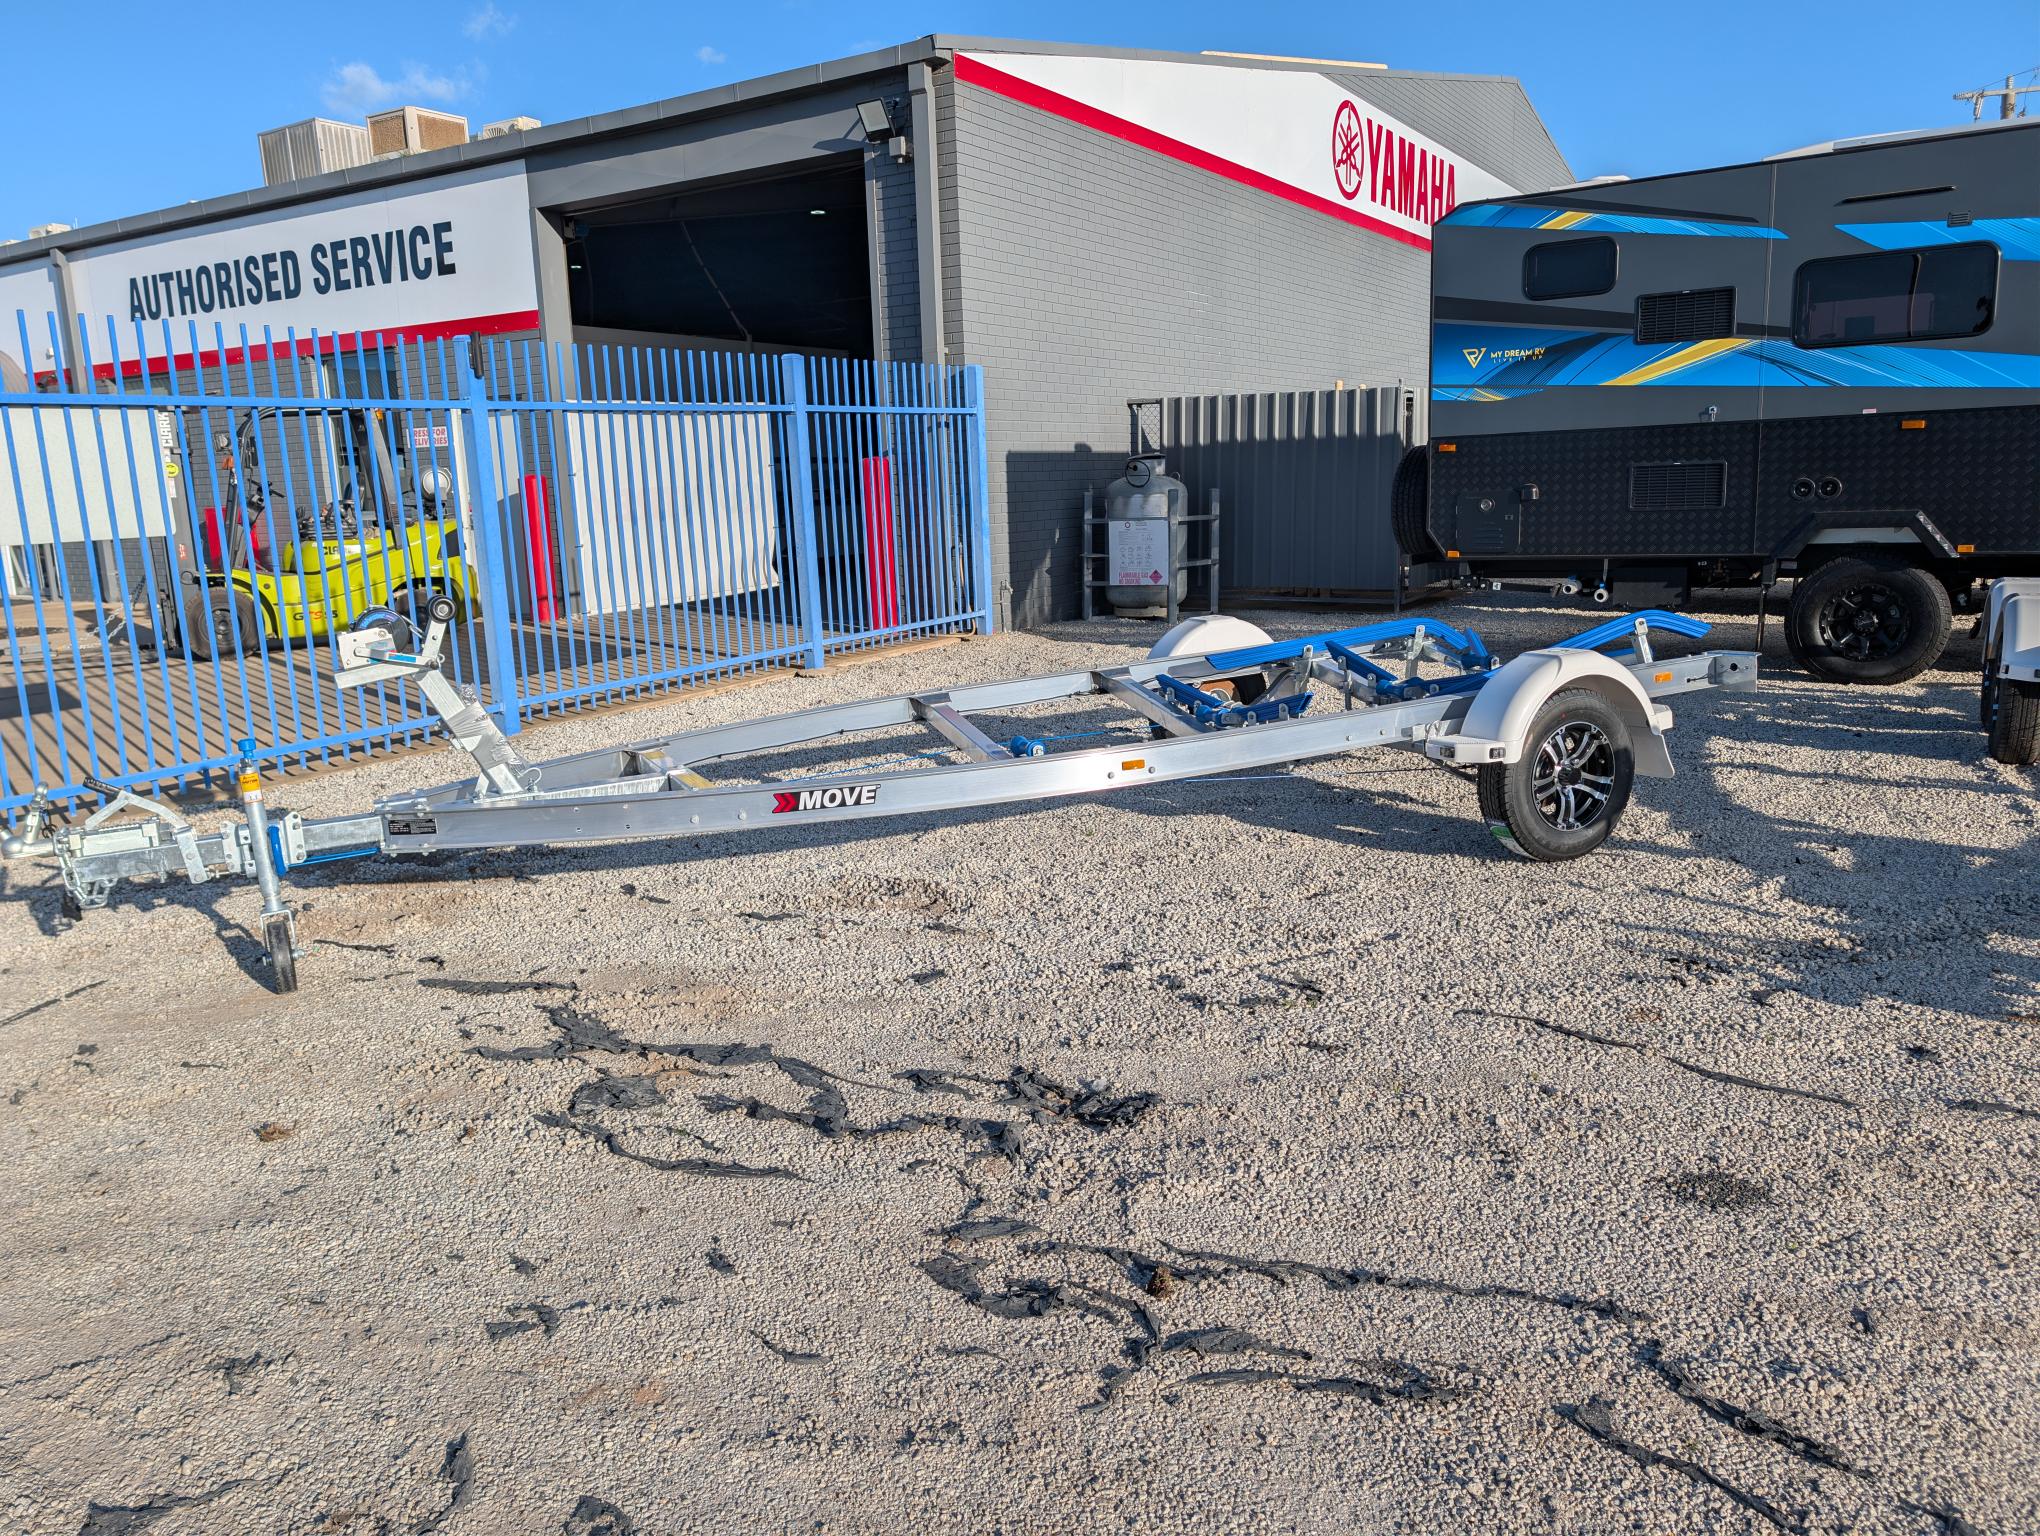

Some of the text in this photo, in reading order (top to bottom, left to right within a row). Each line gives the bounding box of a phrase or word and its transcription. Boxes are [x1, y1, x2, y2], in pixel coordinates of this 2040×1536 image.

[1366, 117, 1456, 227] YAMAHA
[129, 221, 457, 322] AUTHORISED SERVICE
[1490, 347, 1546, 359] MY DREAM RV
[158, 411, 173, 447] CLARK
[798, 785, 877, 811] MOVE
